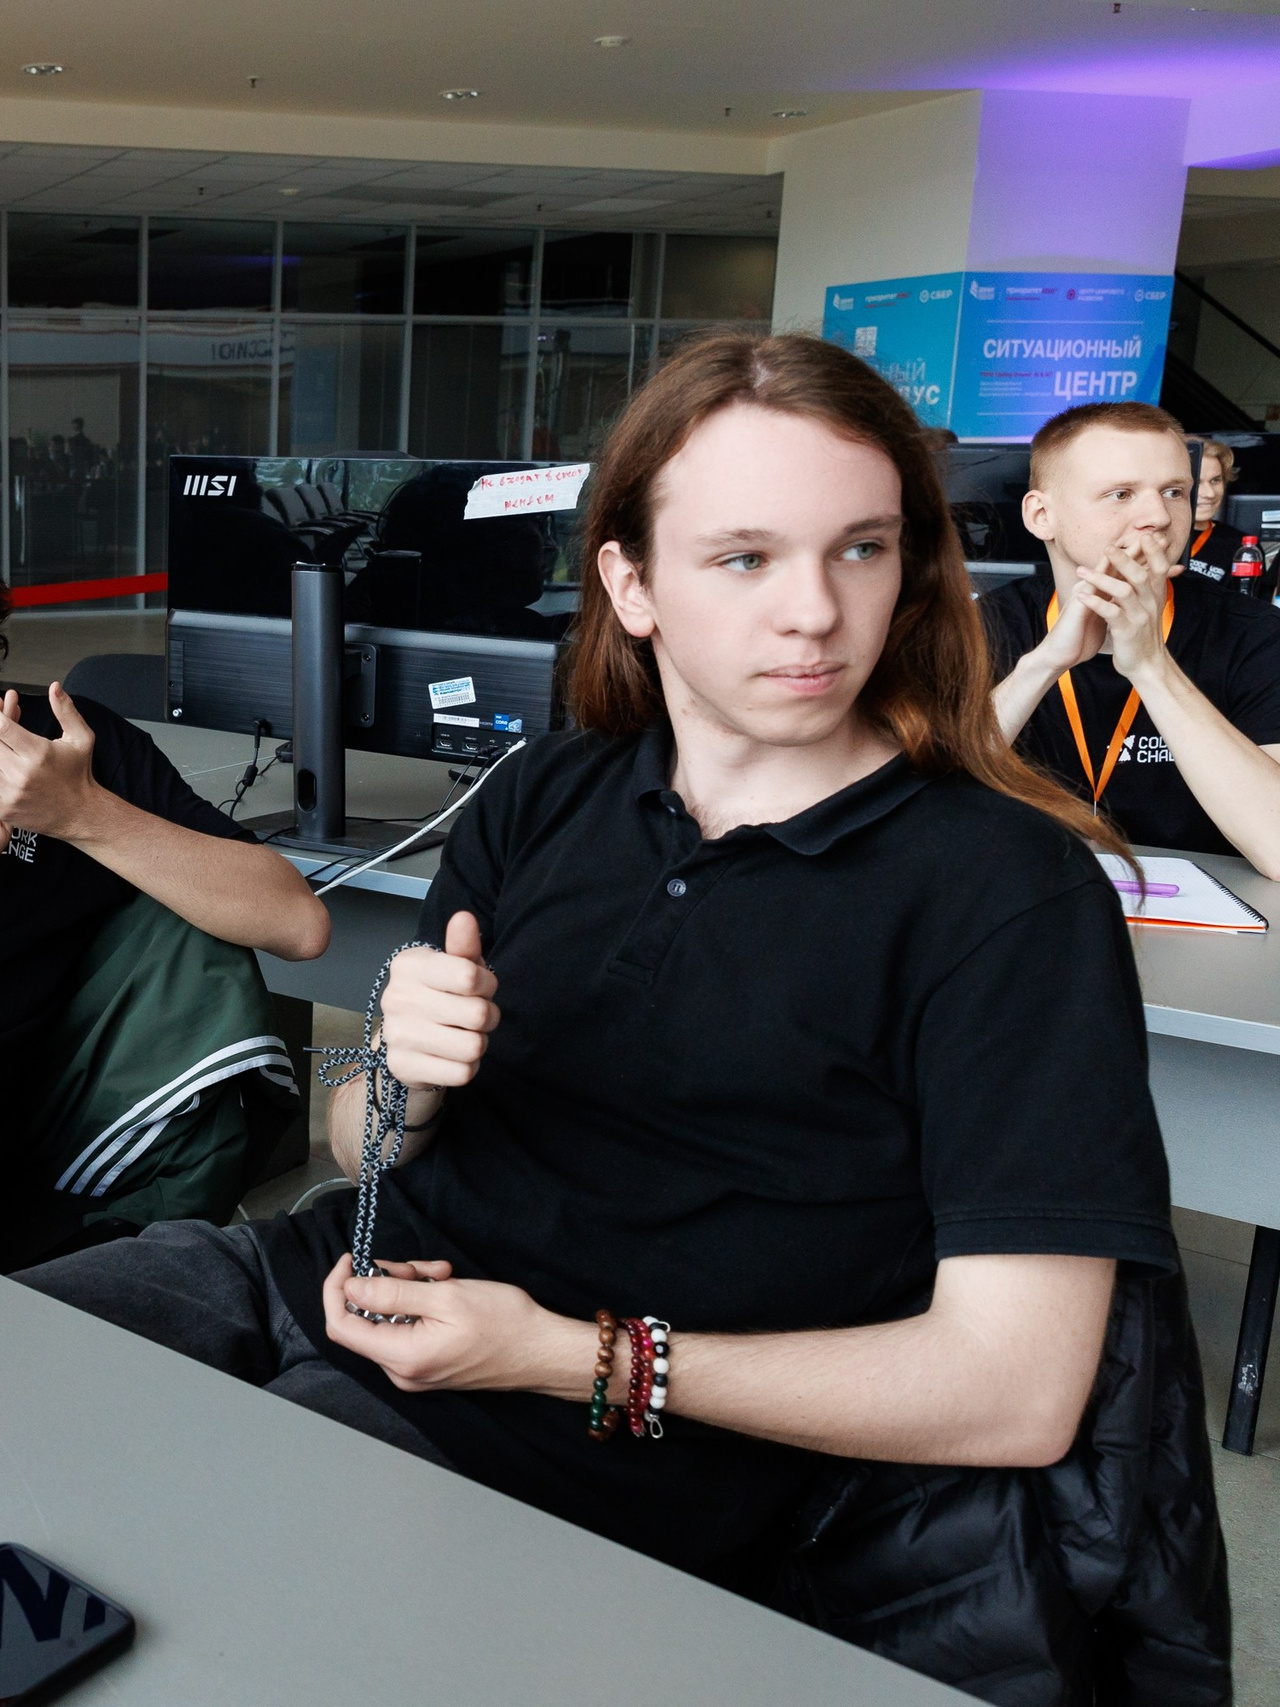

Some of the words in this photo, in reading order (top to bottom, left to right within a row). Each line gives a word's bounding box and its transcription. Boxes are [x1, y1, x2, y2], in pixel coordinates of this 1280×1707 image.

[983, 334, 1143, 361] СИТУАЦИОННЫЙ
[1054, 370, 1138, 401] ЦЕНТР
[183, 475, 237, 497] MSI
